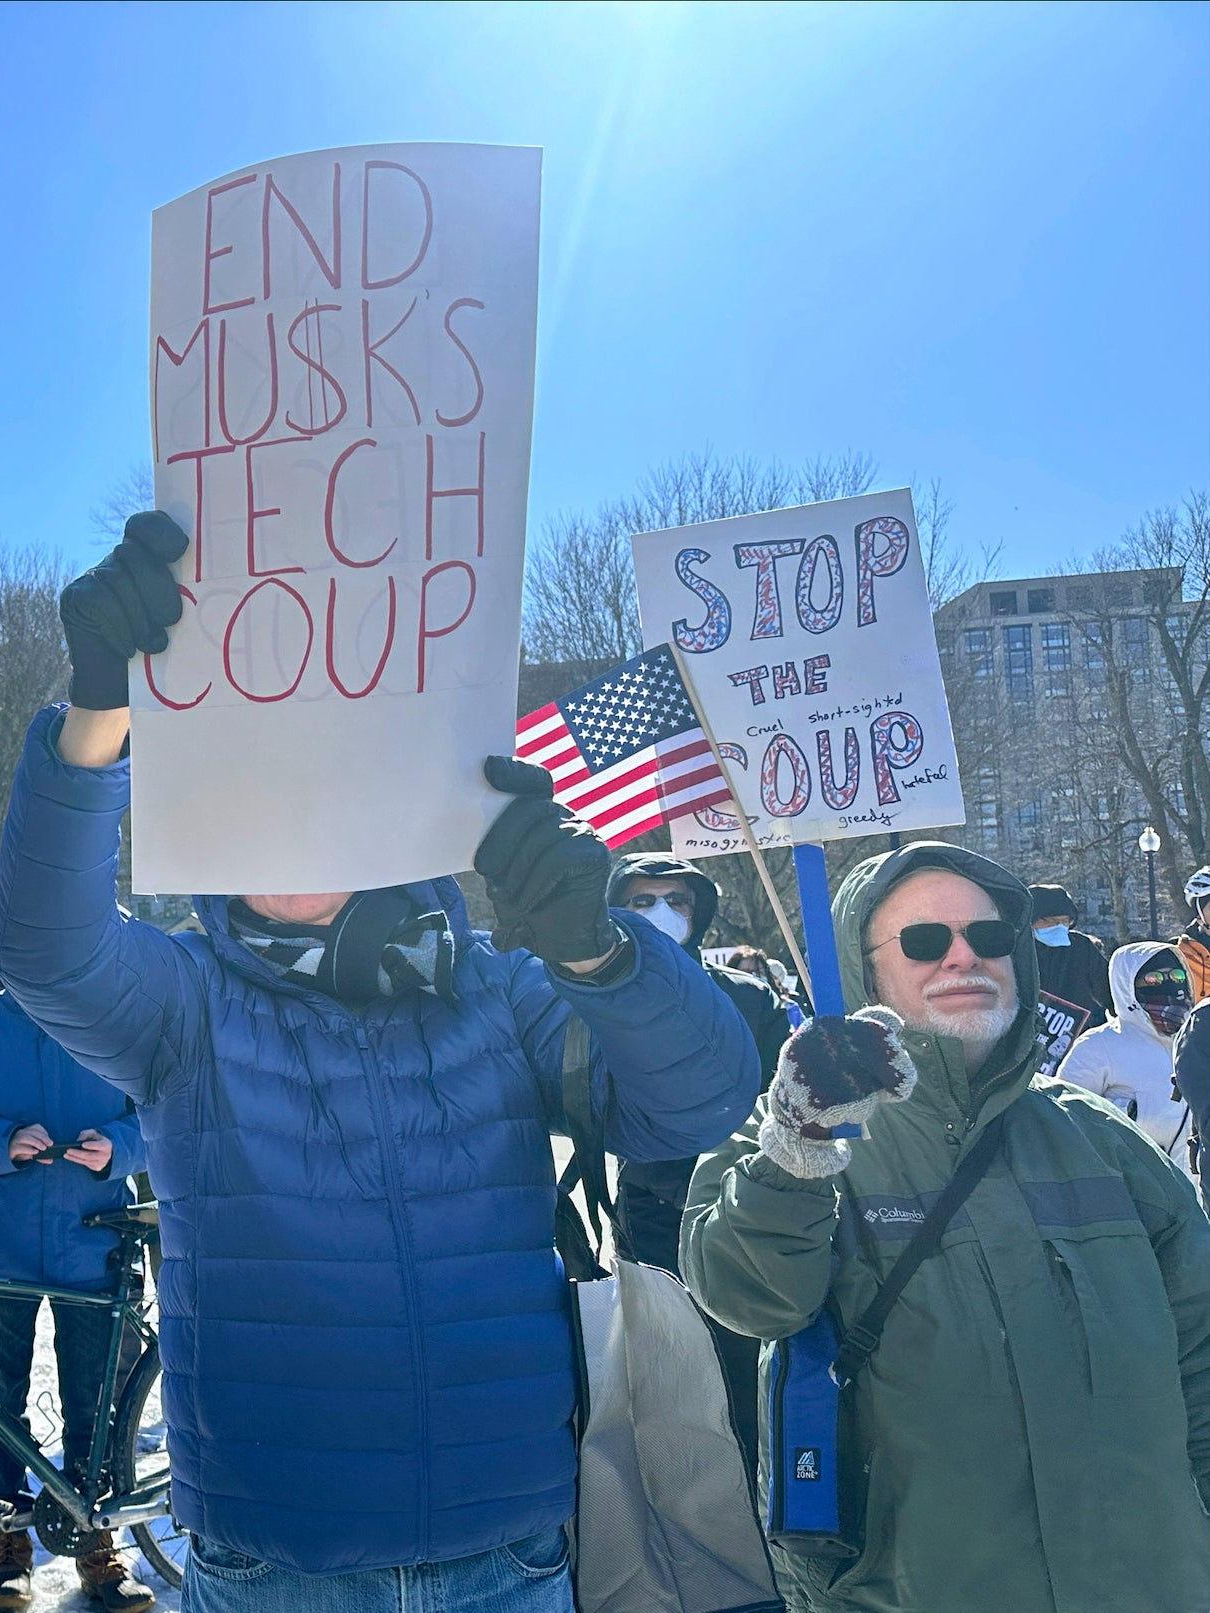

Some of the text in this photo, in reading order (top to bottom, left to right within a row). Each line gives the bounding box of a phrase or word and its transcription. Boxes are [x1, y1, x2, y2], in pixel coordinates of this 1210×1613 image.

[203, 160, 433, 316] END
[167, 432, 486, 582] TECH
[672, 516, 910, 654] STOP
[727, 654, 831, 706] THE
[746, 719, 784, 737] Cruel
[838, 808, 902, 829] greedy
[686, 832, 790, 851] misogynstic
[879, 1207, 925, 1219] Columbi
